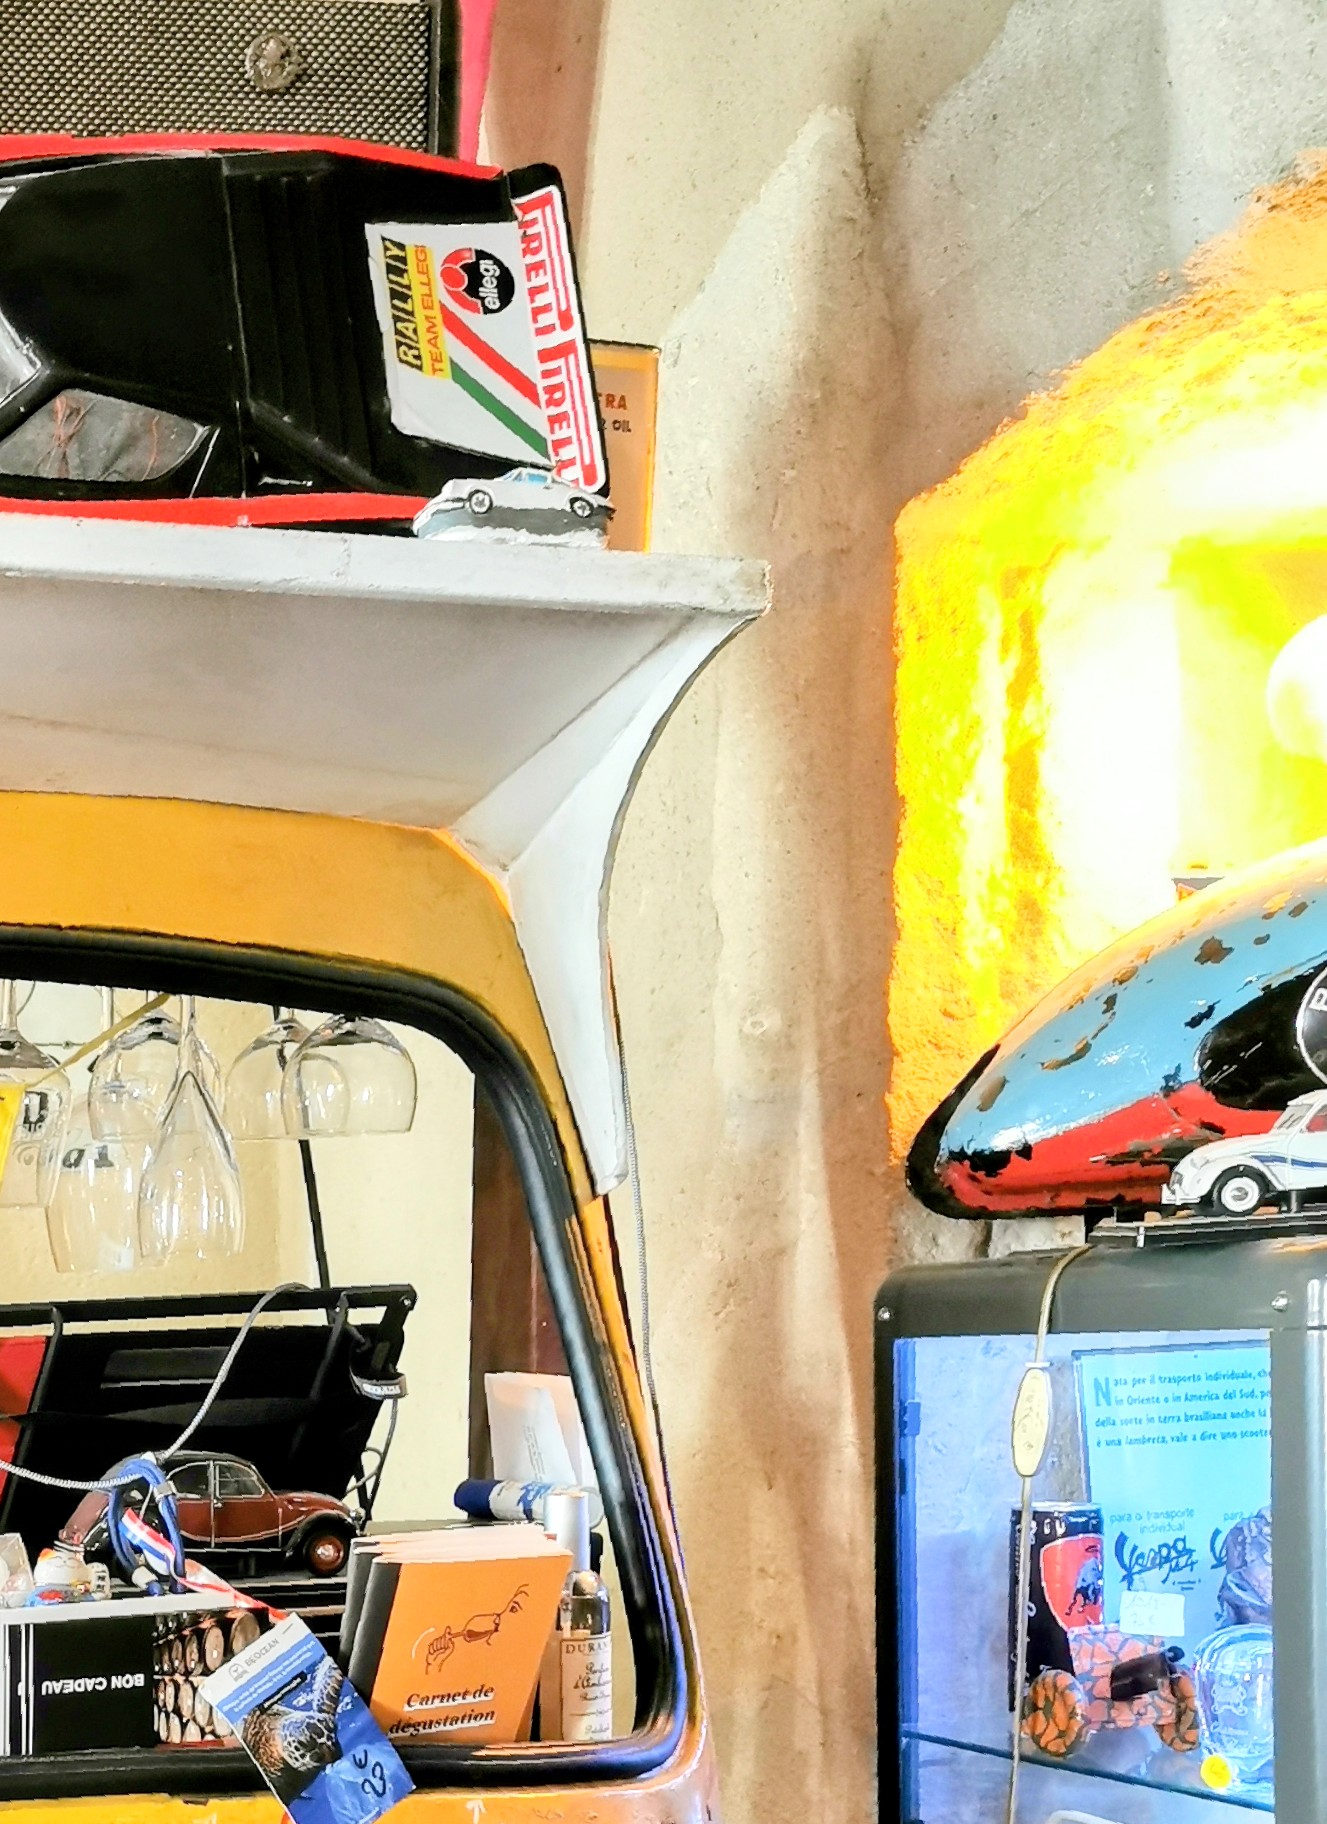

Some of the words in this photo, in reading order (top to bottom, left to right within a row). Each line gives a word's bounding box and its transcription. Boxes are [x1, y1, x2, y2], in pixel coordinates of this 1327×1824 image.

[479, 258, 501, 310] ellegi
[515, 190, 574, 338] PIRELLI
[384, 238, 422, 371] RALLY
[423, 314, 445, 377] TEAM
[41, 1676, 108, 1696] CADEAU
[111, 1672, 145, 1690] BON
[406, 1689, 468, 1708] Carnet
[472, 1682, 495, 1699] de
[389, 1708, 496, 1737] dégustation
